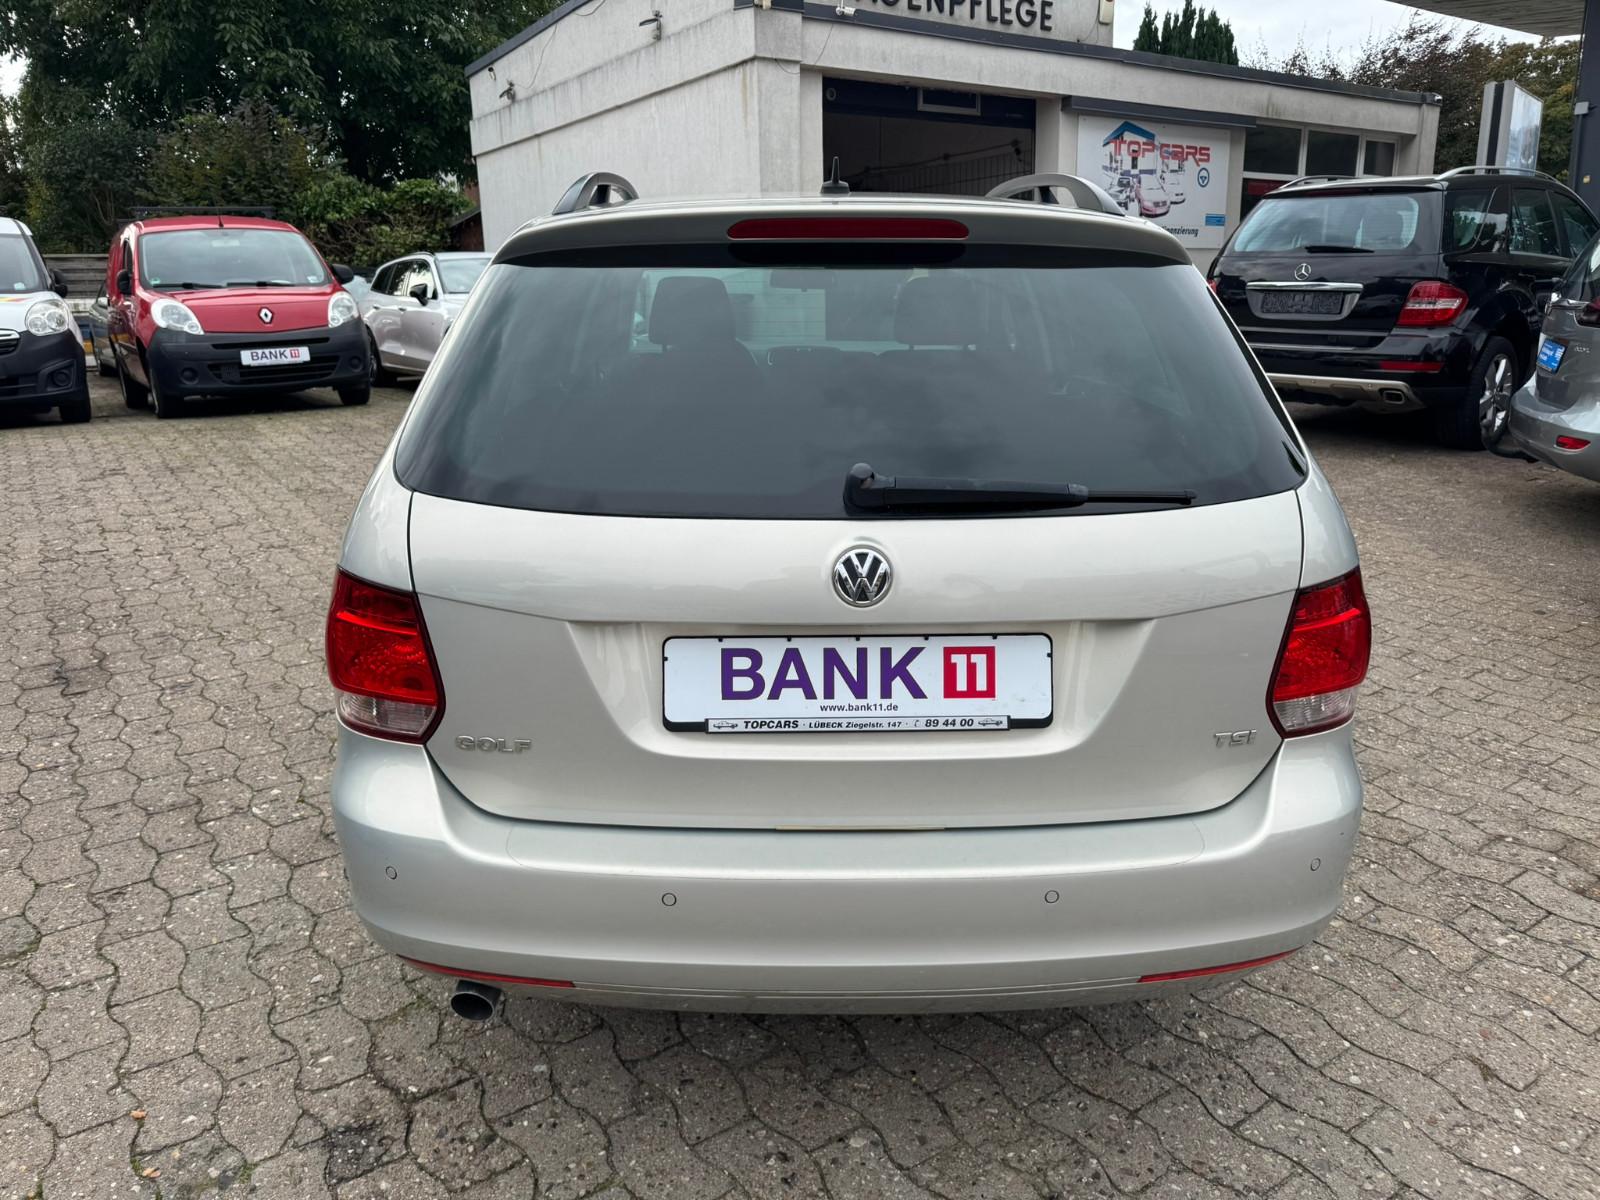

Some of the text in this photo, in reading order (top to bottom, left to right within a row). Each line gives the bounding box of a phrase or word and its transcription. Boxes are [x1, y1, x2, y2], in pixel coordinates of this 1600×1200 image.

[1110, 139, 1156, 158] TOP
[251, 350, 288, 361] BANK
[720, 646, 991, 701] BANK 11
[819, 702, 899, 714] www.bank11.de
[743, 718, 974, 730] TOPCARS LÜBECK Ziegelstr. 147 89 44 00
[455, 734, 532, 754] GOLF
[1213, 729, 1257, 748] TSI
